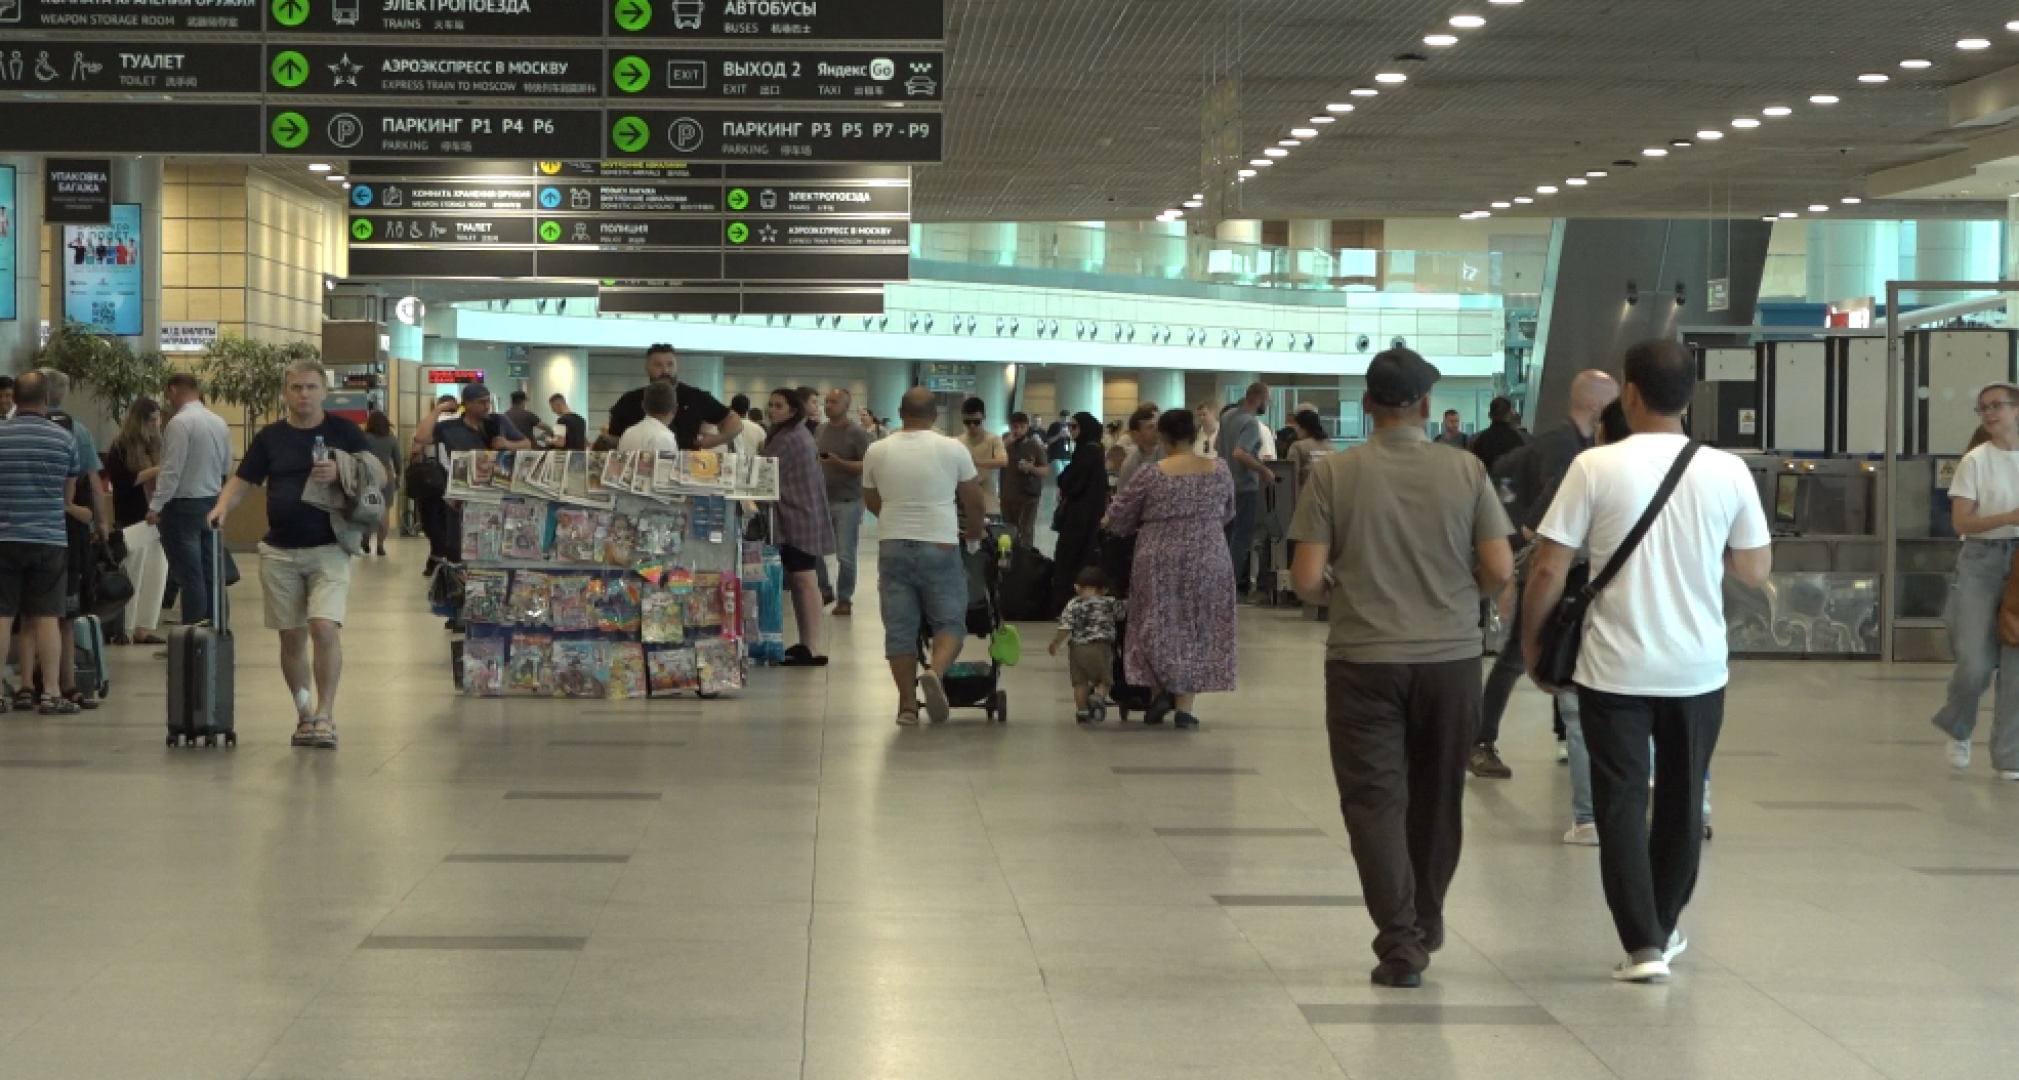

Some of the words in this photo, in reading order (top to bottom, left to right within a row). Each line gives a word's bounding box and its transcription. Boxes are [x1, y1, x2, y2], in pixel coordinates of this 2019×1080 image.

[724, 0, 817, 16] АВТОБУСЫ
[40, 14, 86, 25] WEAPON
[89, 14, 138, 25] STORAGE
[141, 14, 174, 25] ROOM
[383, 18, 421, 29] TRAINS
[724, 22, 759, 33] BUSES
[119, 53, 185, 69] ТУАЛЕТ
[381, 59, 491, 74] АЭРОЭКСПРЕСС
[495, 61, 505, 75] В
[508, 62, 569, 75] МОСКВУ
[674, 68, 700, 80] EXIT
[723, 61, 787, 79] ВЫХОД
[791, 62, 802, 77] 2
[818, 62, 867, 80] Яндекс
[872, 63, 892, 78] Go
[119, 75, 156, 86] TOILET
[381, 79, 424, 91] EXPRESS
[426, 80, 456, 91] TRAIN
[458, 80, 470, 91] TO
[472, 81, 517, 92] MOSCOW
[723, 83, 747, 95] EXIT
[818, 84, 842, 95] TAXI
[383, 118, 464, 134] ПАРКИНГ
[471, 118, 492, 134] P1
[502, 118, 524, 134] P4
[533, 118, 555, 134] P6
[723, 121, 802, 138] ПАРКИНГ
[811, 122, 832, 138] P3
[842, 122, 863, 138] P5
[382, 139, 428, 151] PARKING
[721, 143, 770, 155] PARKING
[51, 171, 107, 182] УПАКОВКА
[57, 182, 101, 193] БАГАЖА
[455, 222, 493, 233] ТУАЛЕТ
[600, 223, 649, 235] ПОЛИЦИЯ
